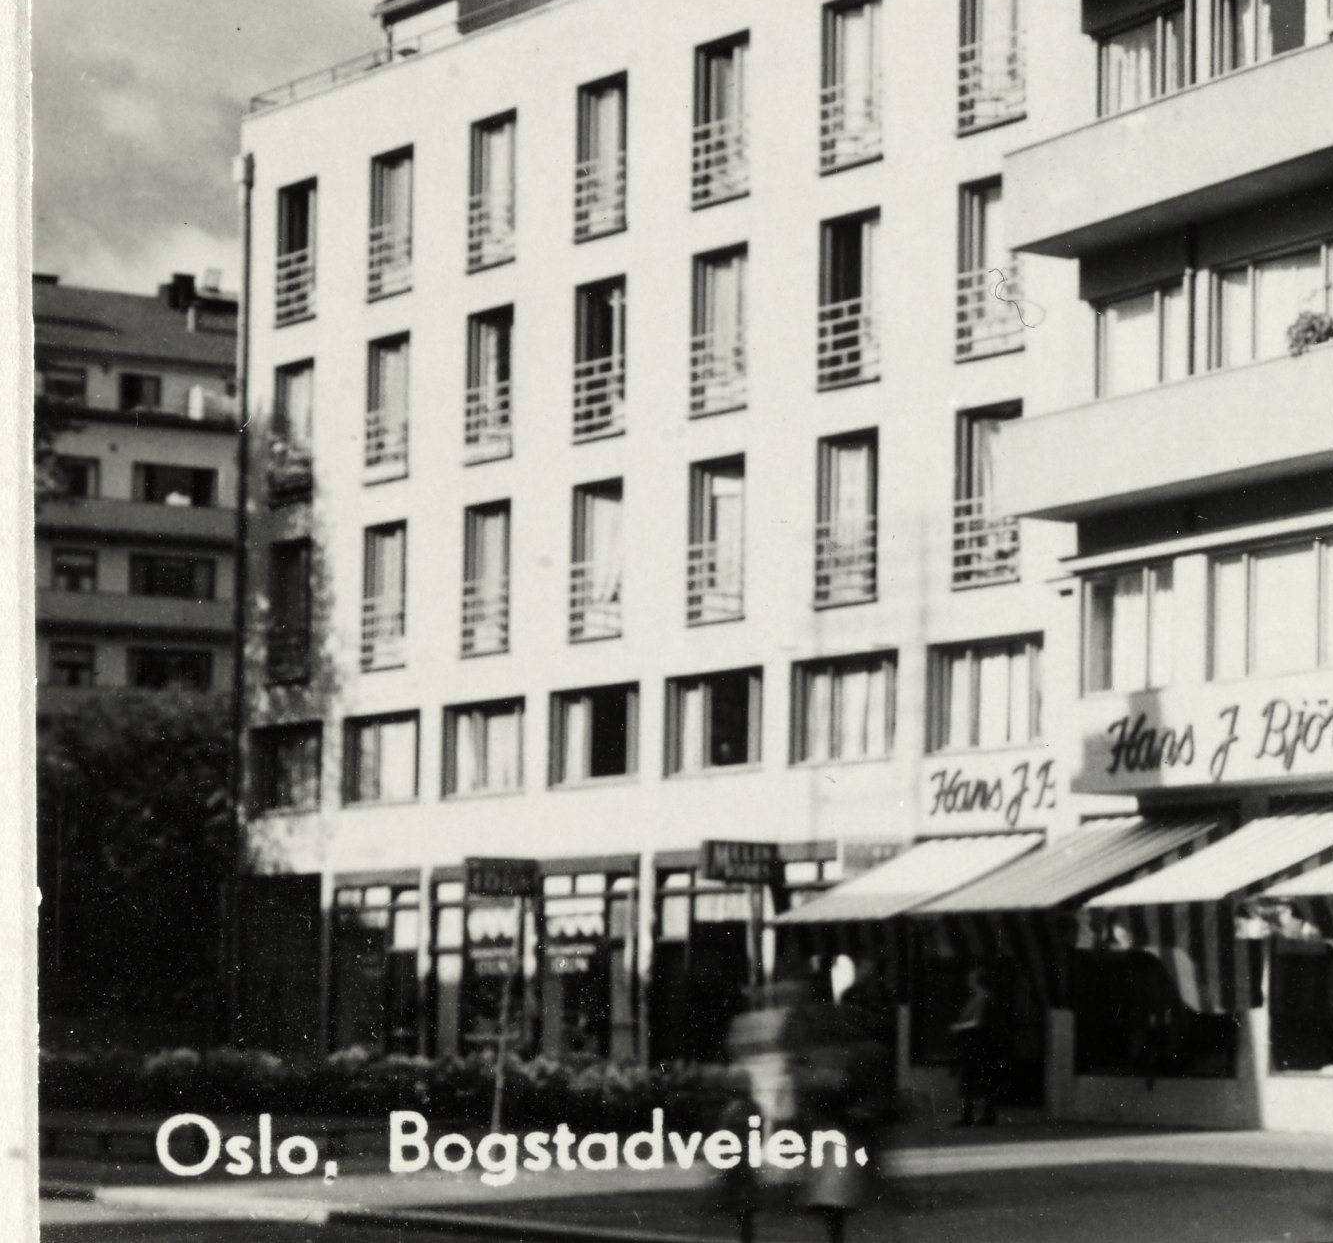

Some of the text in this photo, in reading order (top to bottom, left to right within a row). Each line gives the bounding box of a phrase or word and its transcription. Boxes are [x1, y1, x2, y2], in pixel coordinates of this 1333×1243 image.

[1106, 711, 1195, 775] Hans
[1210, 705, 1240, 783] J
[930, 768, 1003, 816] Hans
[1006, 761, 1030, 828] J
